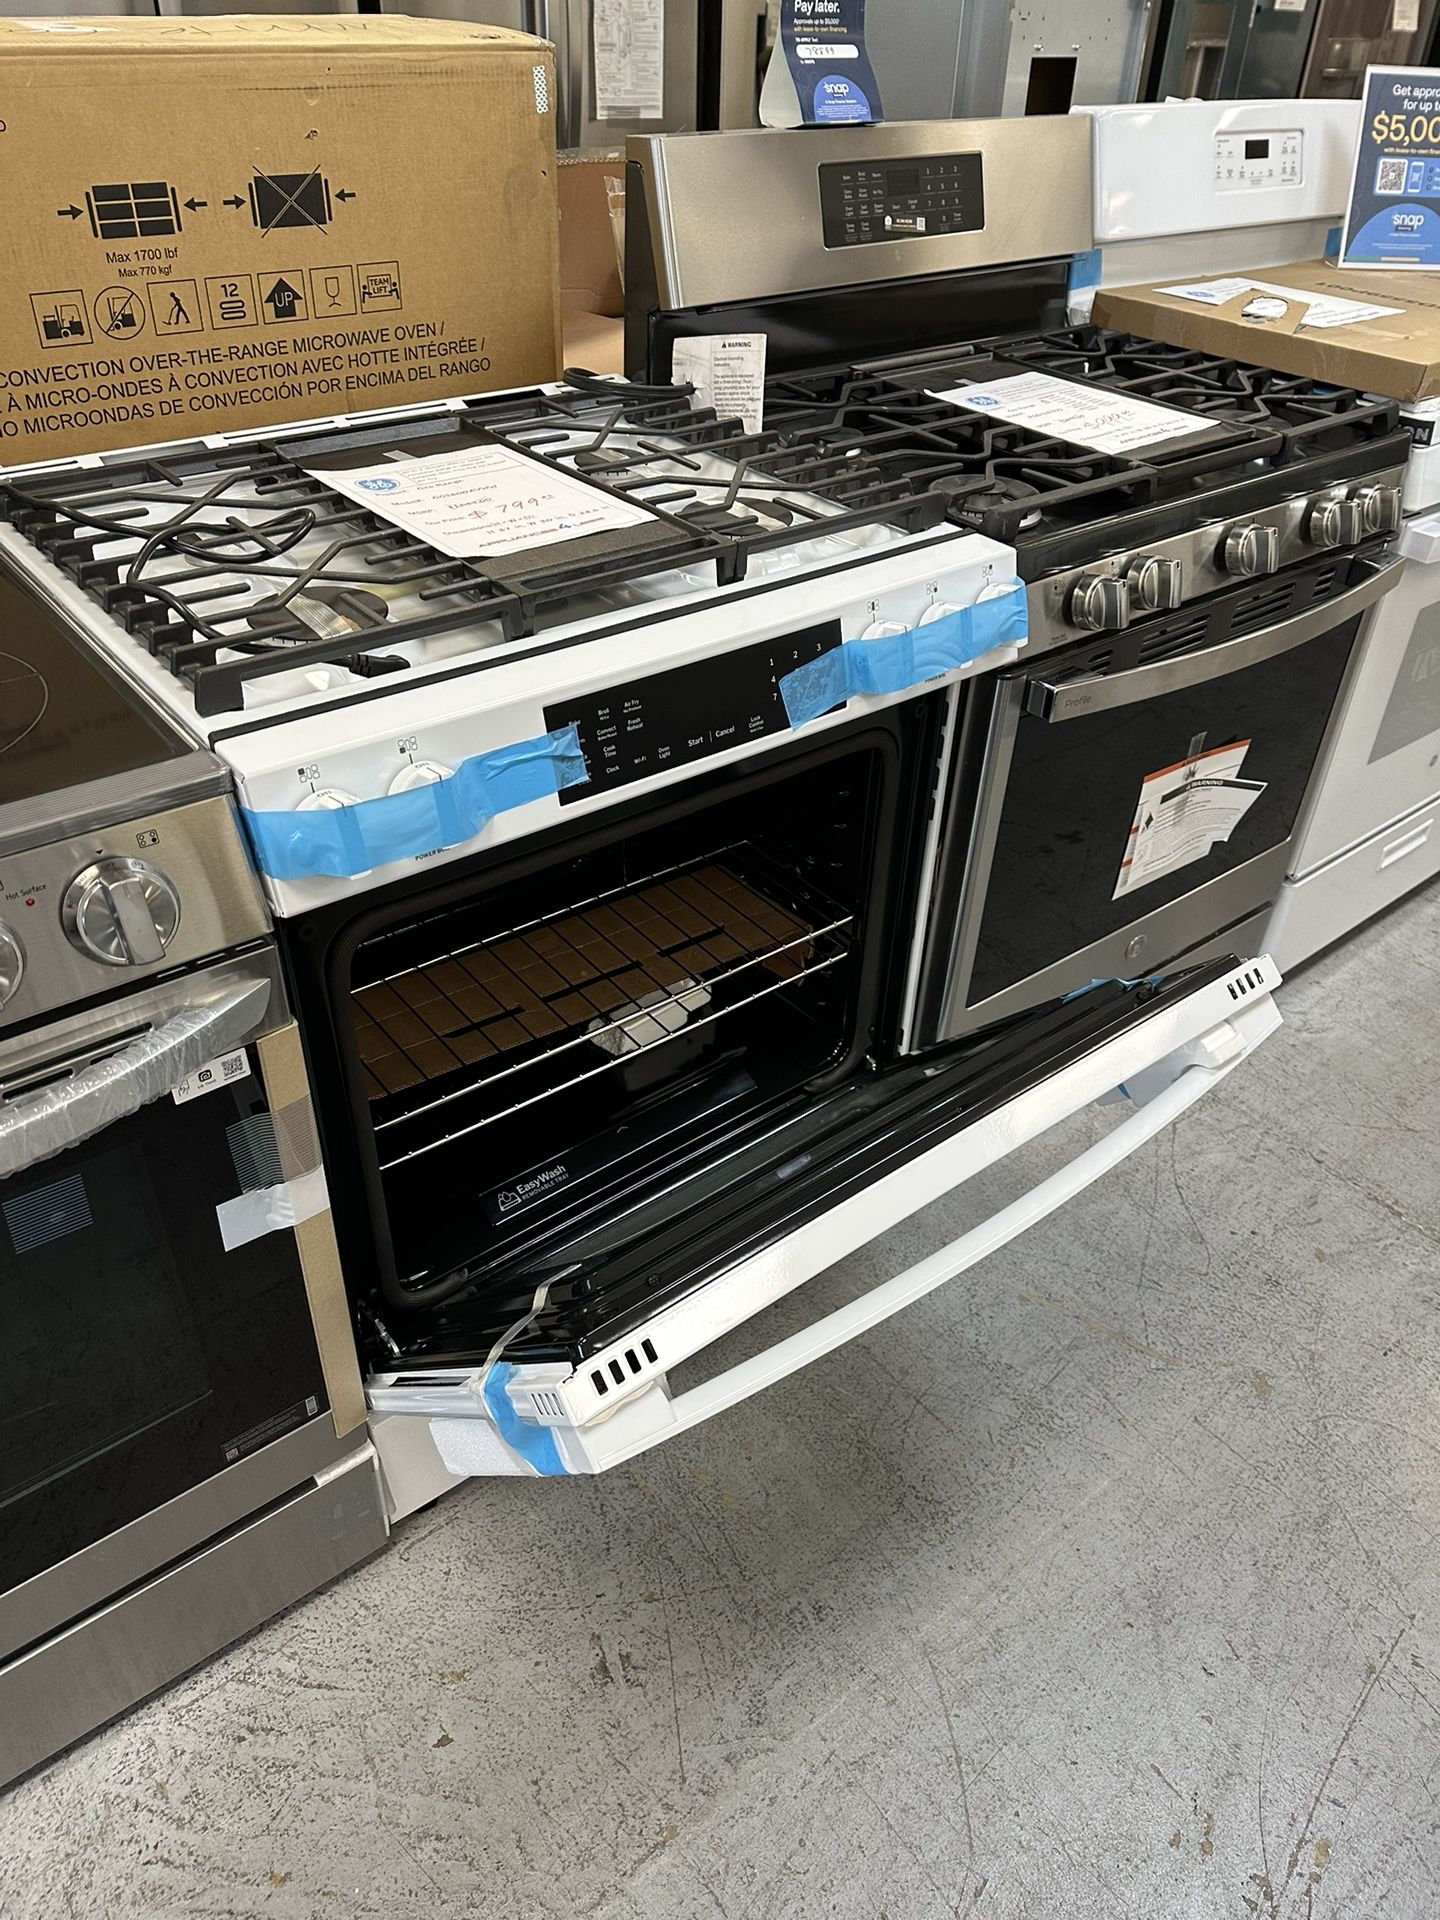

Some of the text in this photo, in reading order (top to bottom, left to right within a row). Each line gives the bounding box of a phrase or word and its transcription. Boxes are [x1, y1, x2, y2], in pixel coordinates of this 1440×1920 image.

[794, 0, 840, 16] Pay later.
[823, 82, 850, 96] snap
[1393, 84, 1412, 96] Get
[1404, 99, 1417, 110] for
[1420, 101, 1433, 113] up
[1392, 212, 1425, 230] snap
[106, 247, 178, 264] Max 1700 lbf
[118, 264, 173, 278] Max 770 kgf
[370, 277, 389, 286] TEAM
[221, 283, 238, 298] 12
[374, 286, 388, 295] LIFT
[274, 292, 294, 308] UP
[130, 340, 288, 373] OVER-THE-RANGE
[292, 327, 390, 354] MICROWAVE
[394, 322, 436, 340] OVEN
[8, 392, 22, 412] À
[26, 378, 163, 410] MICRO-ONDES
[168, 373, 180, 392] À
[184, 362, 298, 390] CONVECTION
[302, 355, 344, 374] AVEC
[348, 348, 399, 368] HOTTE
[404, 336, 478, 361] INTÉGRÉE
[24, 403, 155, 434] MICROONDAS
[160, 399, 184, 416] DE
[189, 382, 302, 412] CONVECCIÓN
[306, 378, 342, 396] POR
[346, 369, 406, 390] ENCIMA
[408, 366, 436, 382] DEL
[440, 357, 491, 378] RANGO
[816, 643, 821, 651] 3
[792, 650, 798, 658] 2
[769, 658, 774, 666] 1
[772, 692, 778, 700] 7
[598, 708, 610, 716] Broil
[596, 725, 617, 736] Convect
[715, 725, 736, 738] Cancel
[603, 744, 616, 752] Cook
[688, 736, 704, 747] Start
[604, 750, 617, 758] Time
[634, 756, 646, 764] Wi-Fi
[658, 750, 671, 759] Light
[606, 765, 620, 774] Clock
[415, 849, 436, 862] POWER
[6, 884, 47, 900] Hot Surface
[516, 1165, 566, 1194] EasyWash
[521, 1172, 570, 1200] REMOVABLE TRAY
